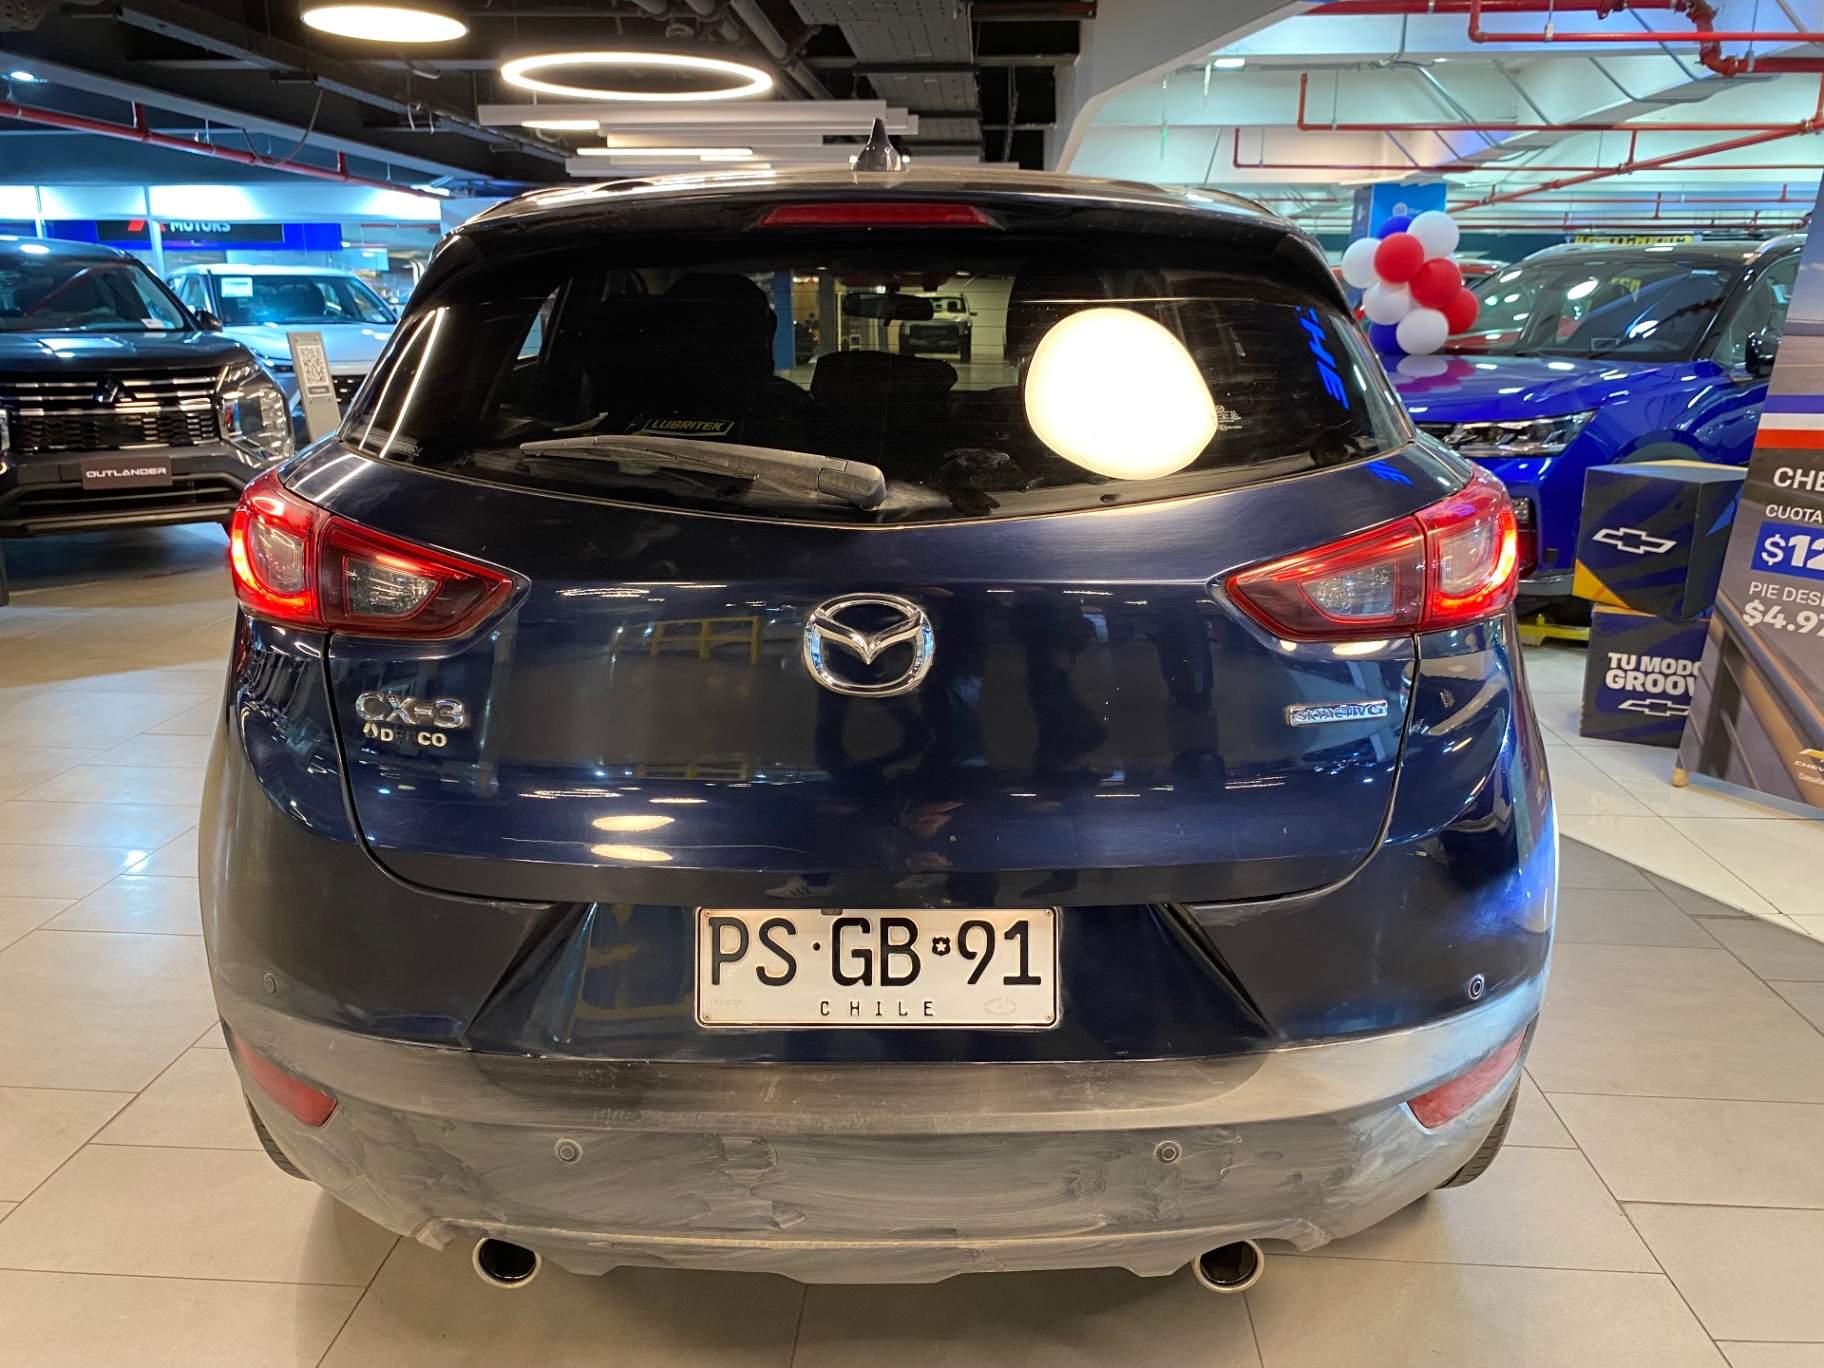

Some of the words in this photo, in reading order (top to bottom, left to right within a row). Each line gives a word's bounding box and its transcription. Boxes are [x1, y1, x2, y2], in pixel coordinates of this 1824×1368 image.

[652, 419, 726, 431] LUBRITEK
[85, 467, 167, 478] OUTLANDER
[1765, 503, 1823, 523] CUOTA
[1749, 581, 1780, 599] PIE
[1782, 586, 1824, 608] DES
[1608, 652, 1637, 670] TU
[355, 692, 465, 729] CX-3
[820, 1000, 934, 1017] CHILE
